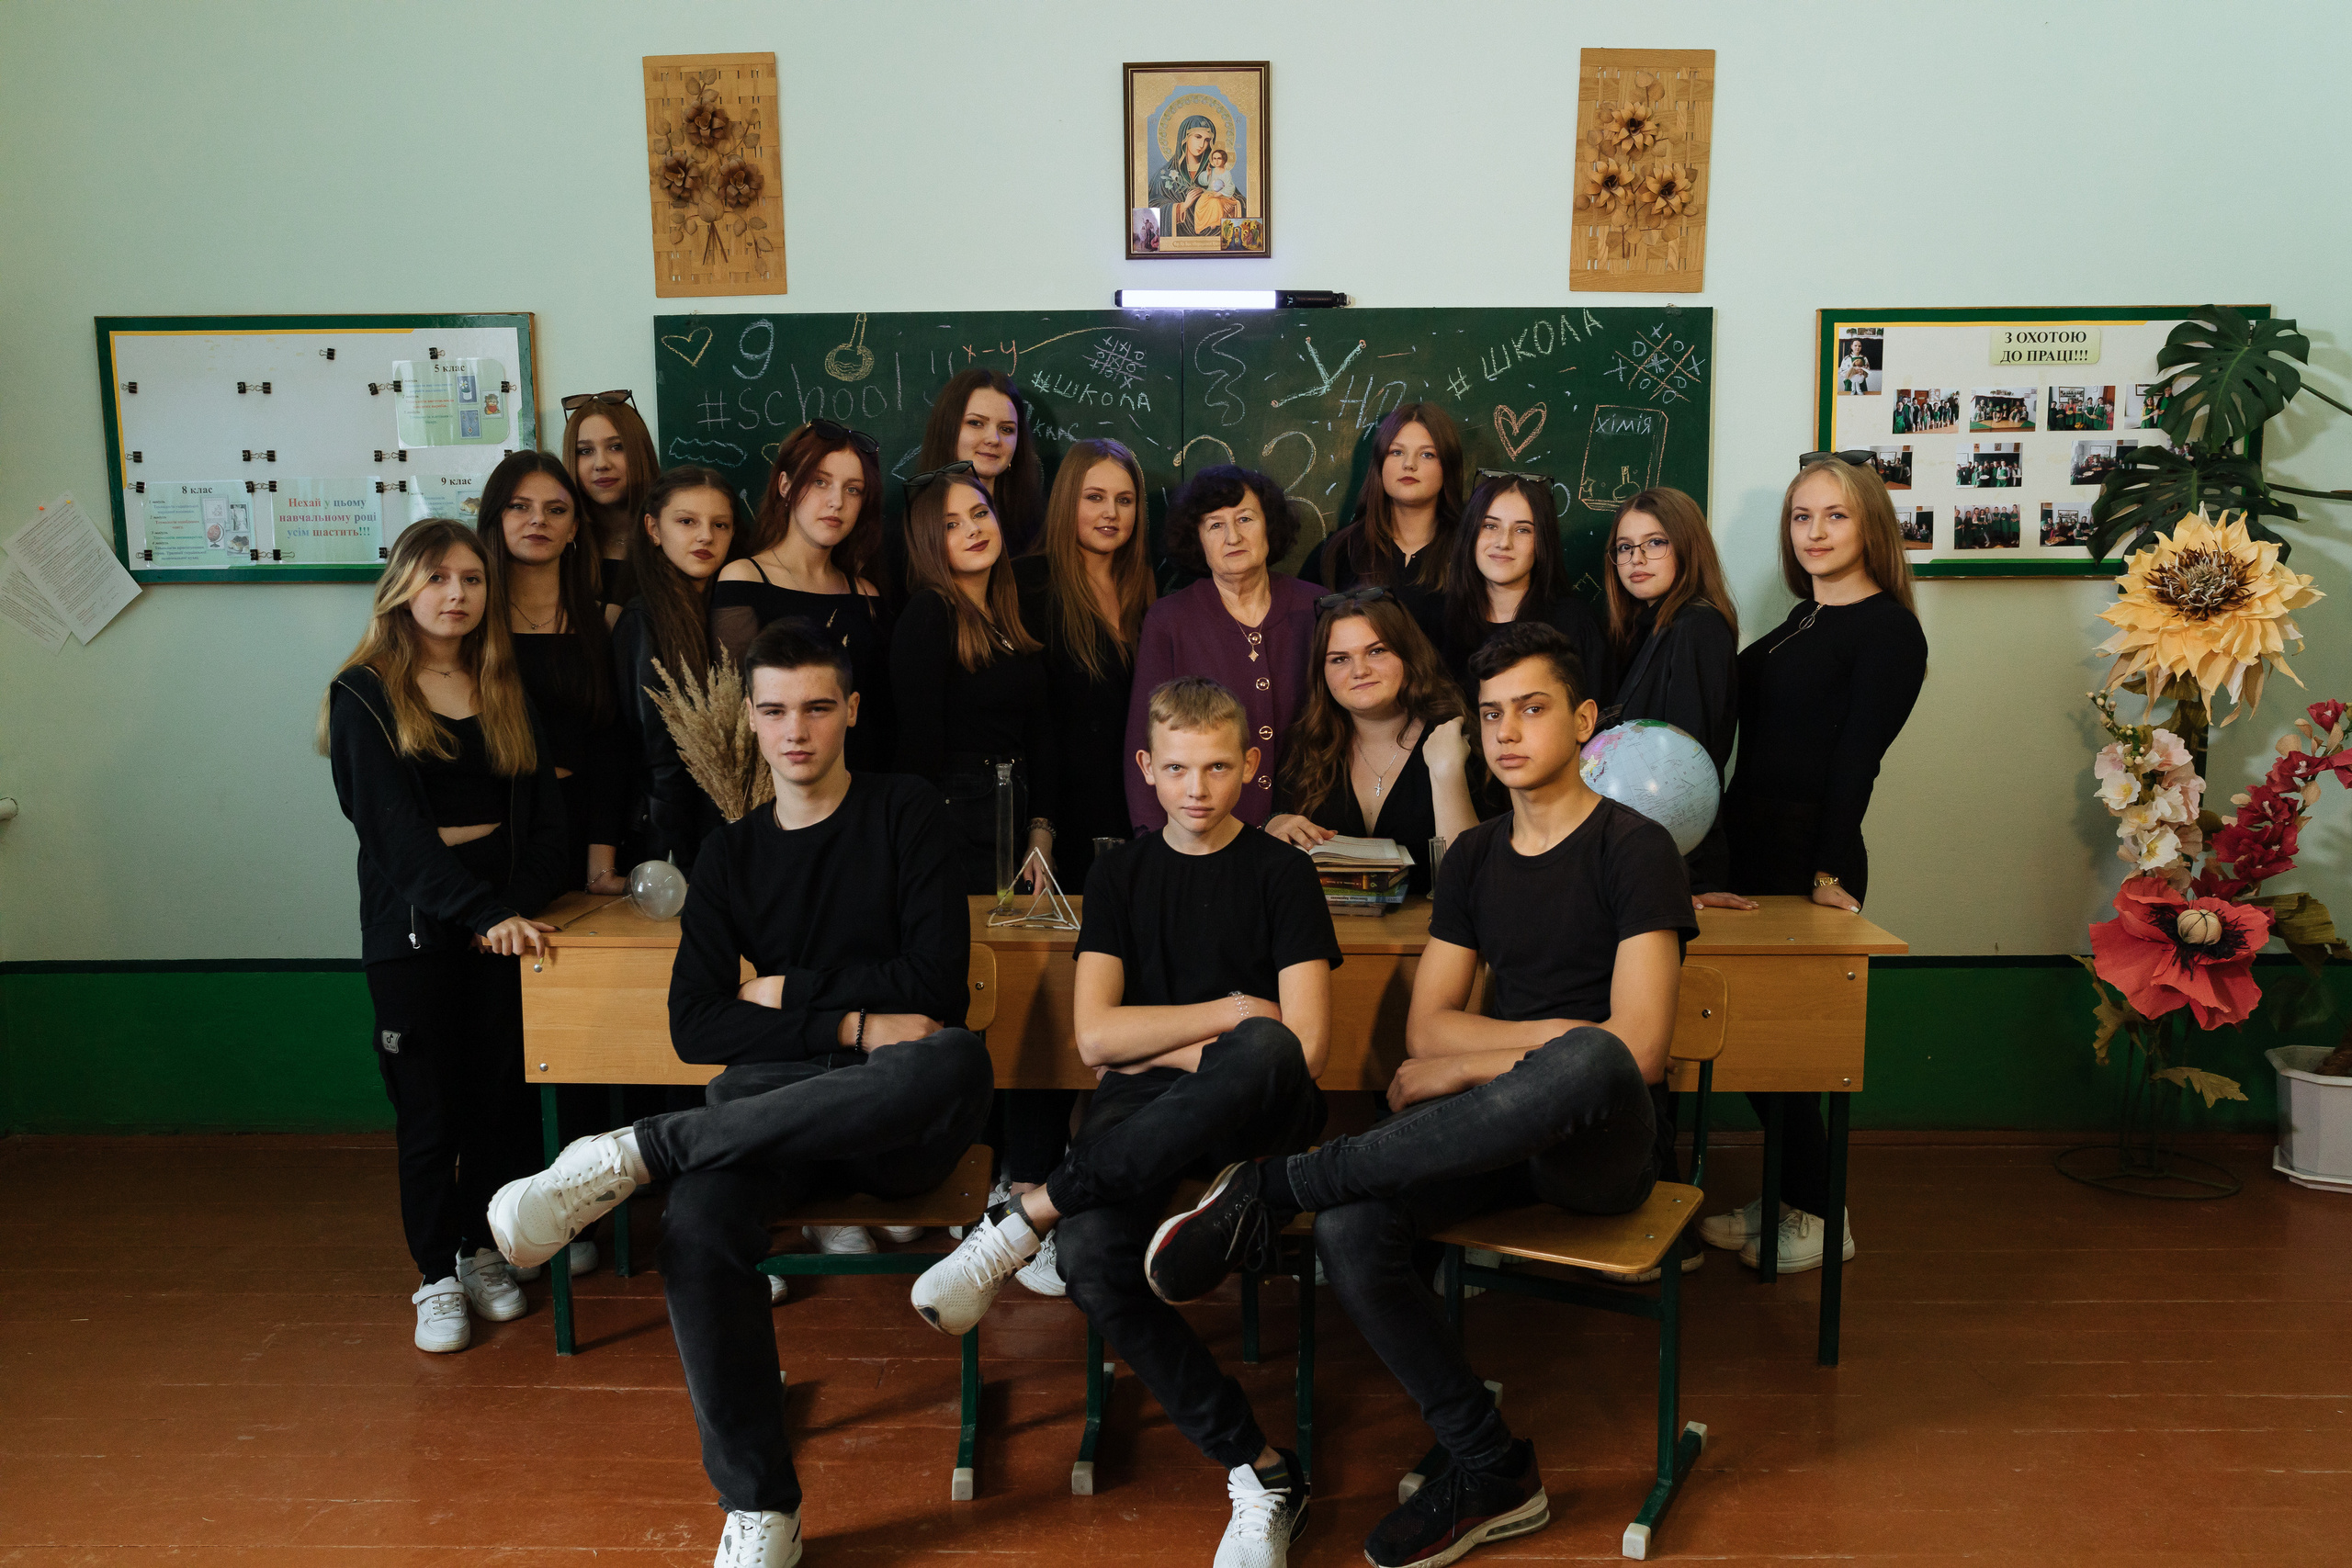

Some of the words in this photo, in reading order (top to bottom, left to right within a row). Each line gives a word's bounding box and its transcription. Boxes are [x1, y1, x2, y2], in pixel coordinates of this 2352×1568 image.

[2016, 331, 2087, 344] ОХОТОЮ
[732, 318, 775, 380] 9
[1999, 350, 2023, 364] ДО
[2027, 349, 2088, 364] ПРАЦІ!!!
[434, 364, 440, 373] 5
[442, 364, 466, 373] клас
[441, 477, 447, 486] 9
[449, 477, 472, 486] клас
[181, 485, 188, 494] 8
[190, 486, 213, 494] клас
[288, 498, 322, 507] Нехай
[324, 500, 330, 509] у
[334, 499, 367, 509] цьому
[279, 514, 351, 524] навчальному
[354, 513, 377, 524] році
[287, 527, 310, 538] усім
[312, 526, 370, 537] щастить!!!
